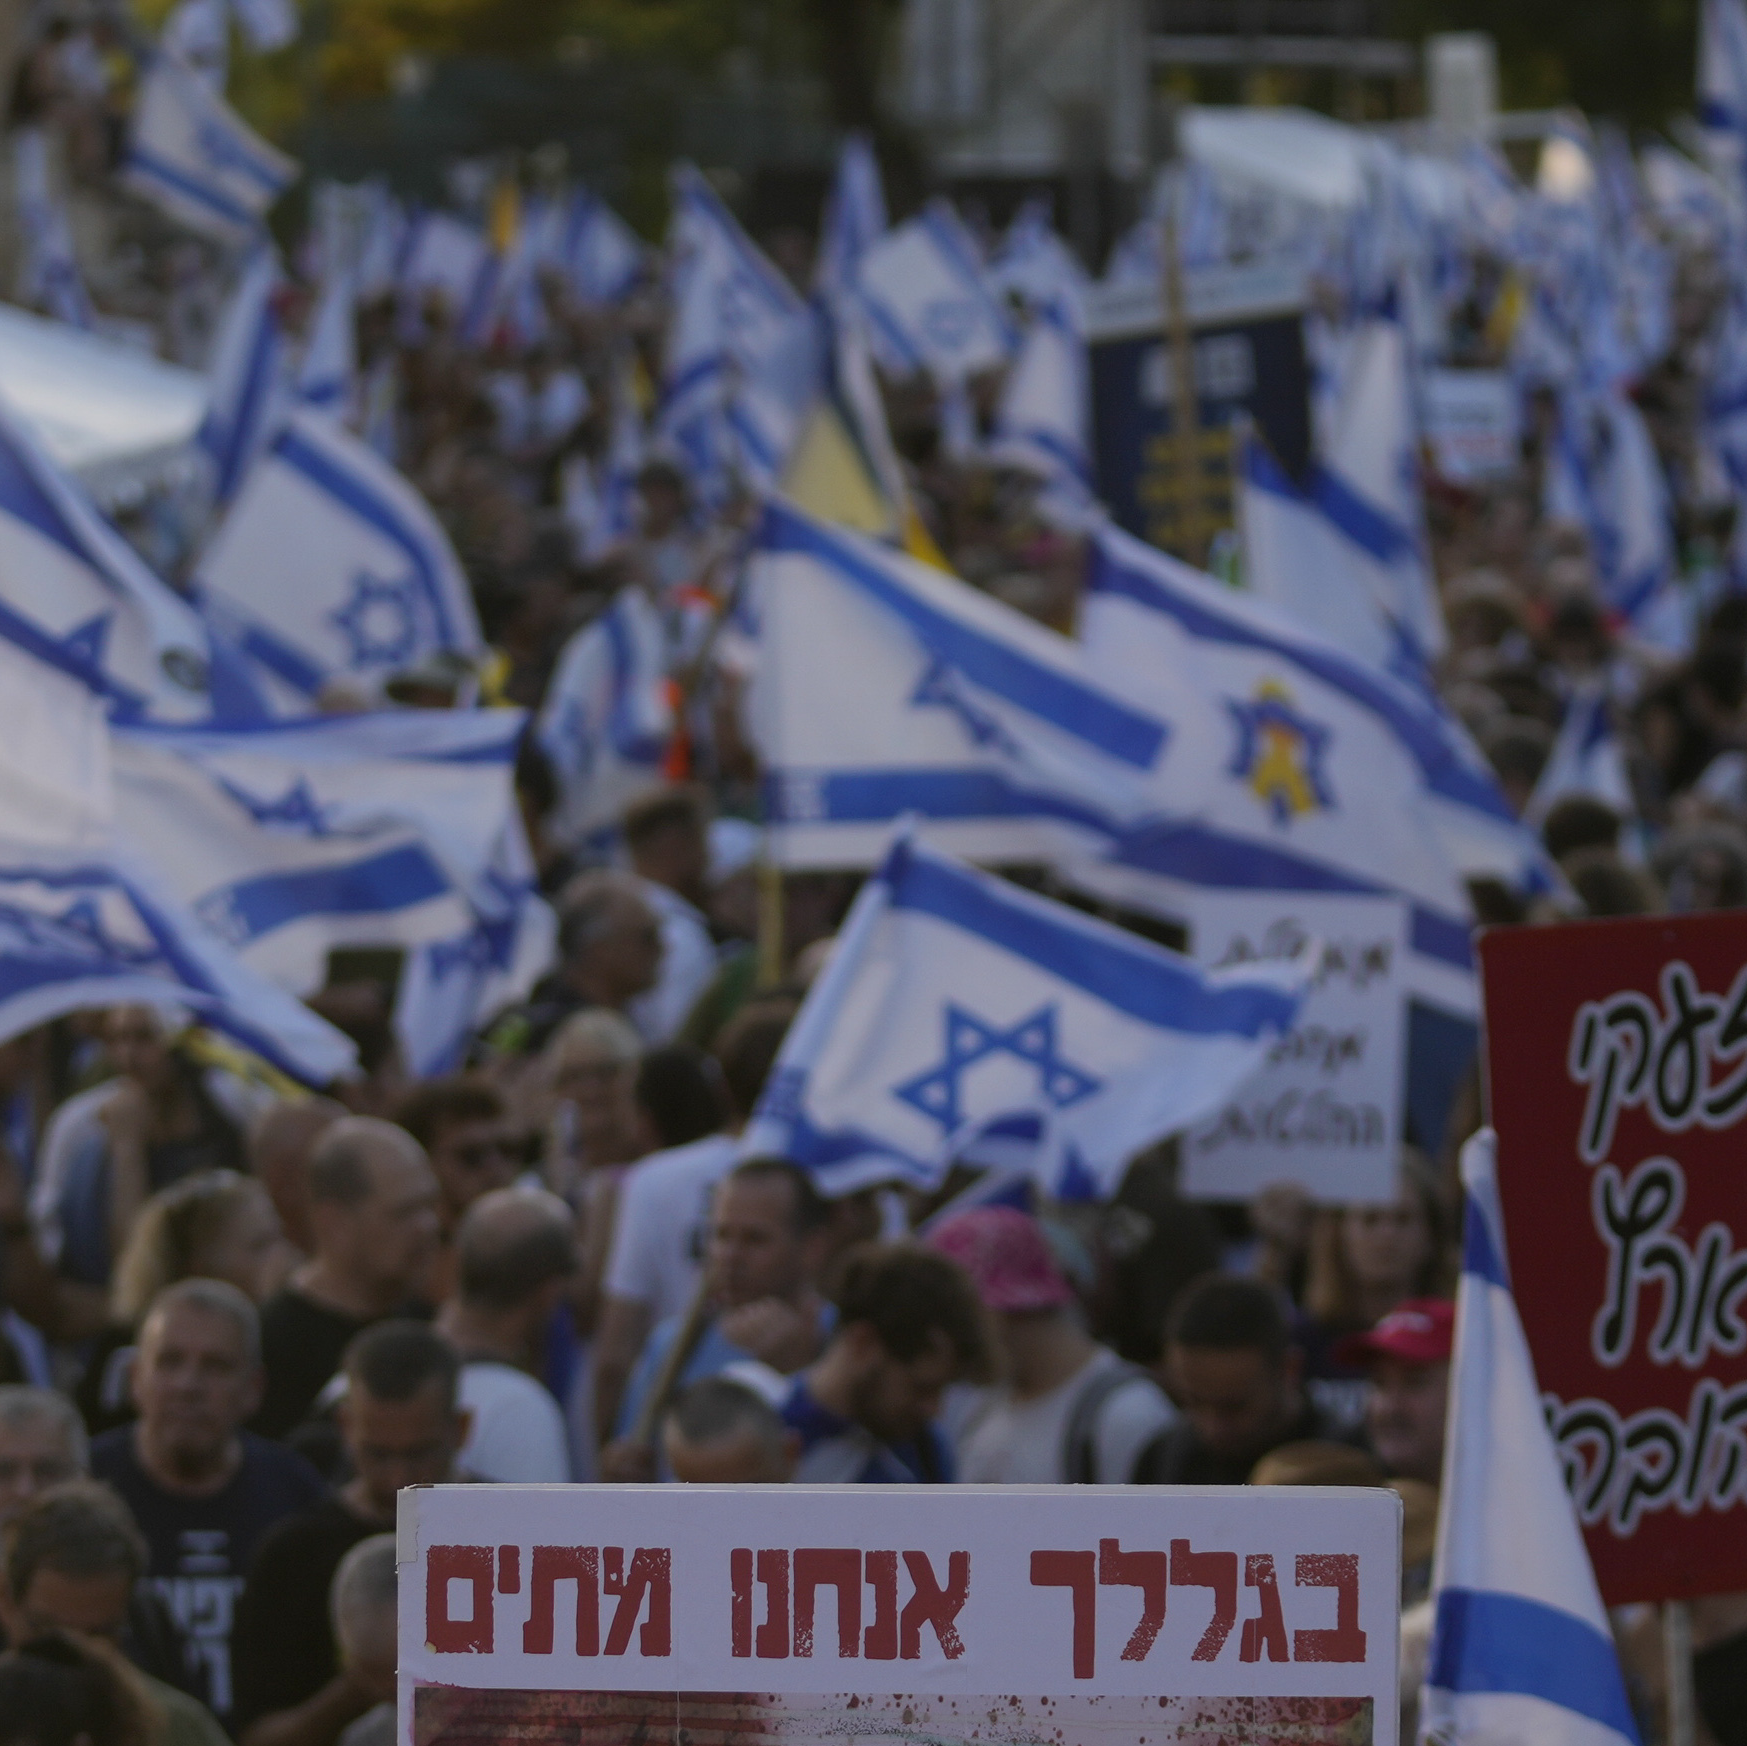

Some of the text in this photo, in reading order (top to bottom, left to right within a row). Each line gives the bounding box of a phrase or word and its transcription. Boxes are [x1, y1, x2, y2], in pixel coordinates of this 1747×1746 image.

[426, 1537, 1367, 1679] בגללך אנחנו מתים
